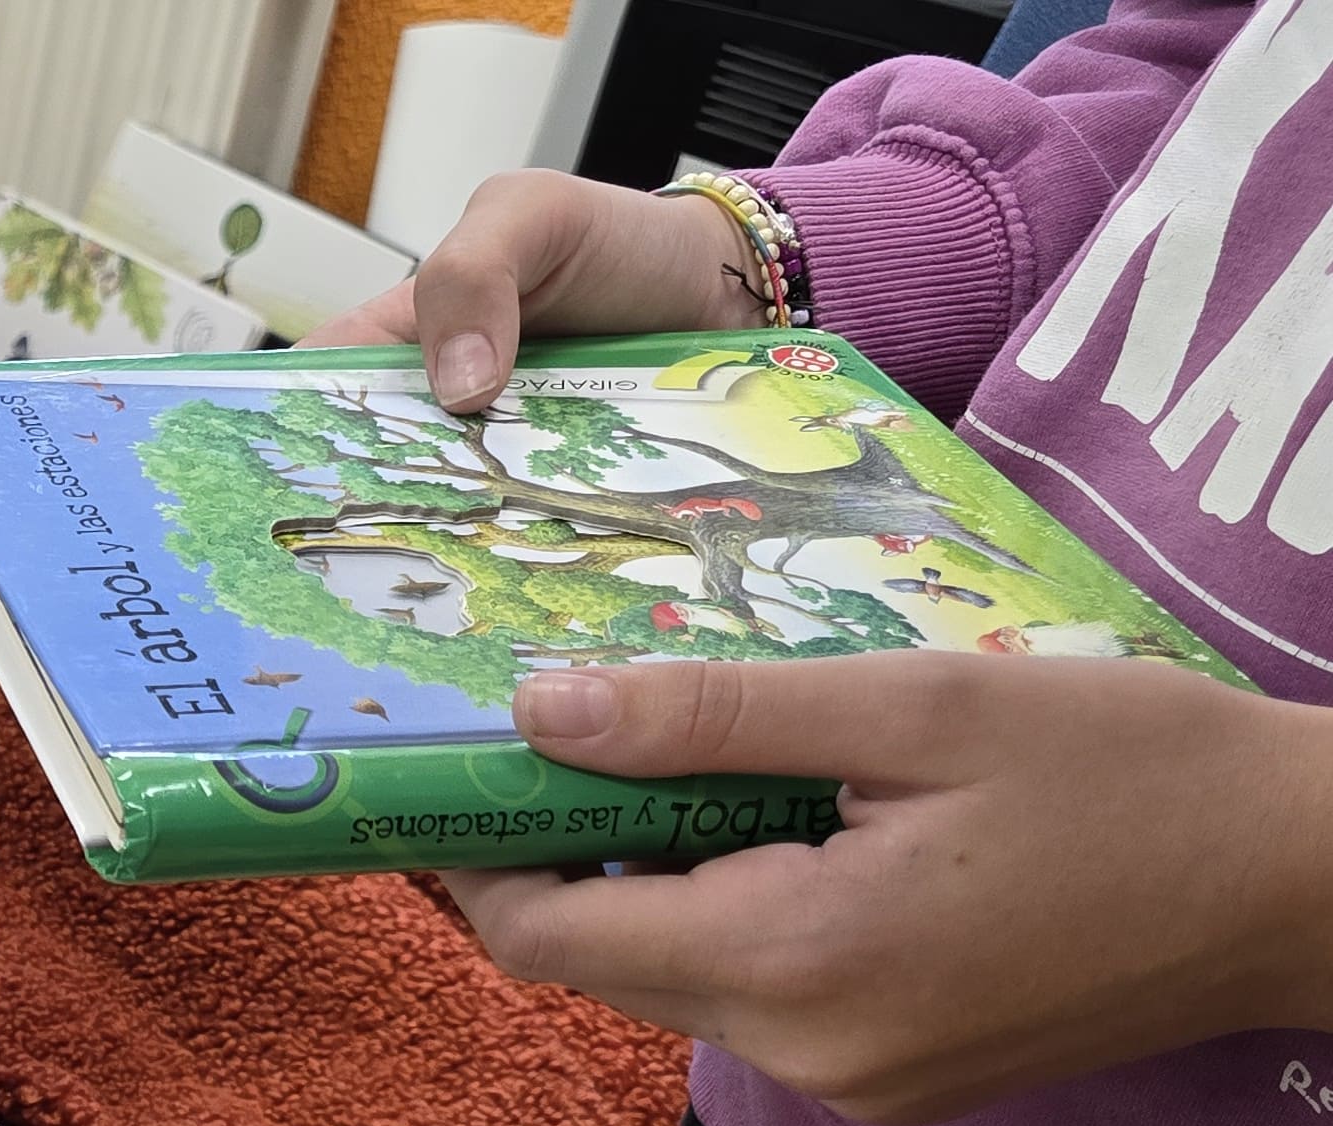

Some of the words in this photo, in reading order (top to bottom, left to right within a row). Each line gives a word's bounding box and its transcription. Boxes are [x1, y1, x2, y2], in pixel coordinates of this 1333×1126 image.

[66, 504, 113, 536] las
[97, 541, 135, 554] y
[68, 561, 198, 664] árbol
[145, 678, 235, 719] El
[350, 807, 556, 845] estaciones
[566, 805, 624, 838] las
[633, 796, 657, 827] y
